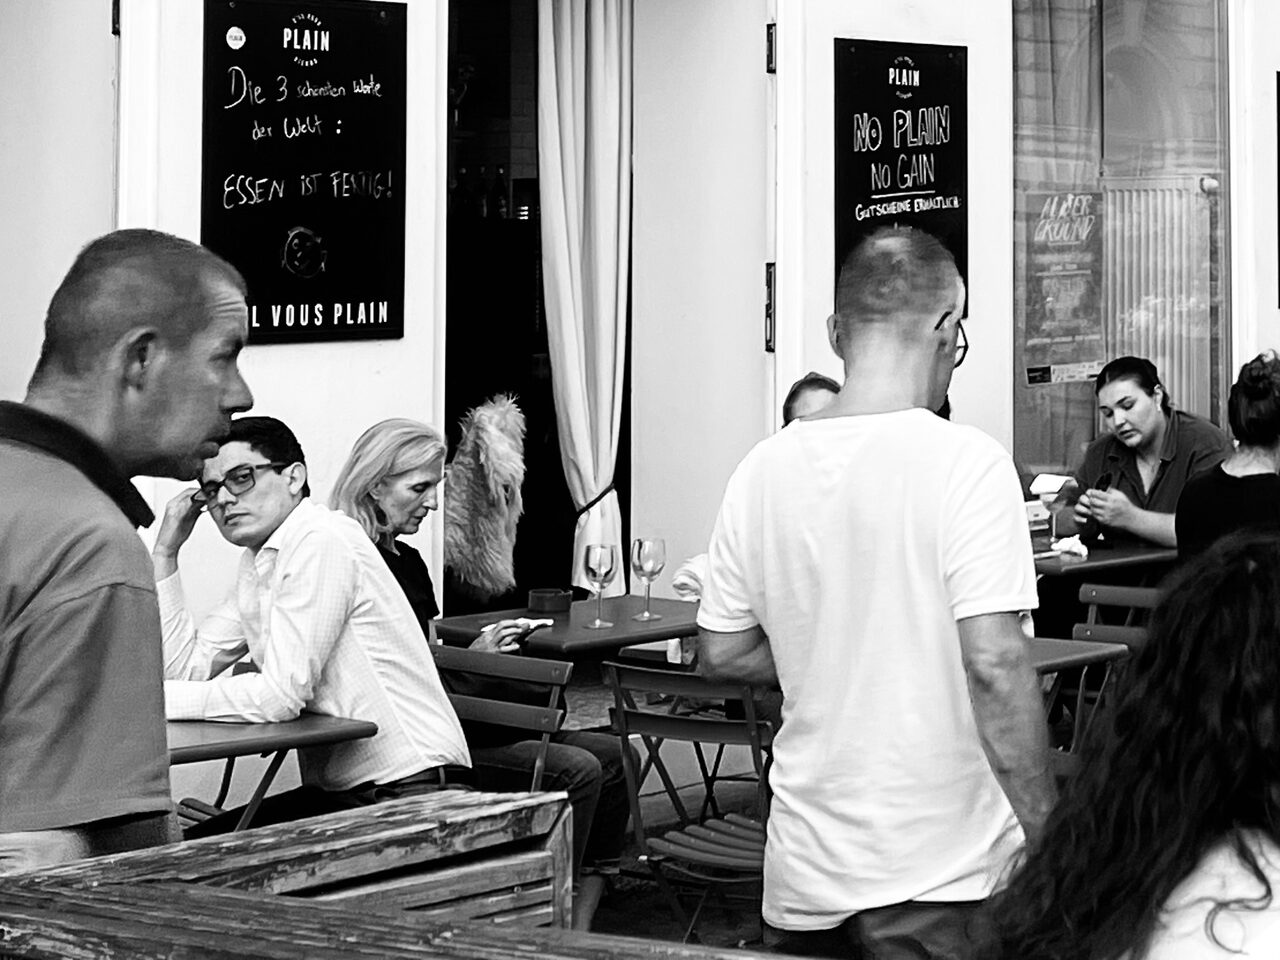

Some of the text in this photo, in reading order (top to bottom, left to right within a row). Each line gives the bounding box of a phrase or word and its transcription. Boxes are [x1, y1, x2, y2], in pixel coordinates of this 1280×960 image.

[283, 28, 331, 52] PLAIN
[224, 66, 266, 109] Die
[276, 75, 288, 102] 3
[353, 73, 383, 98] Worte
[888, 67, 920, 87] PLAIN
[252, 119, 272, 140] der
[853, 105, 950, 153] NO PLAIN
[870, 152, 935, 191] NO GAIN
[223, 174, 285, 210] ESSEN
[330, 169, 393, 200] FERTIG!
[271, 303, 323, 327] VOUS
[333, 301, 389, 326] PLAIN
